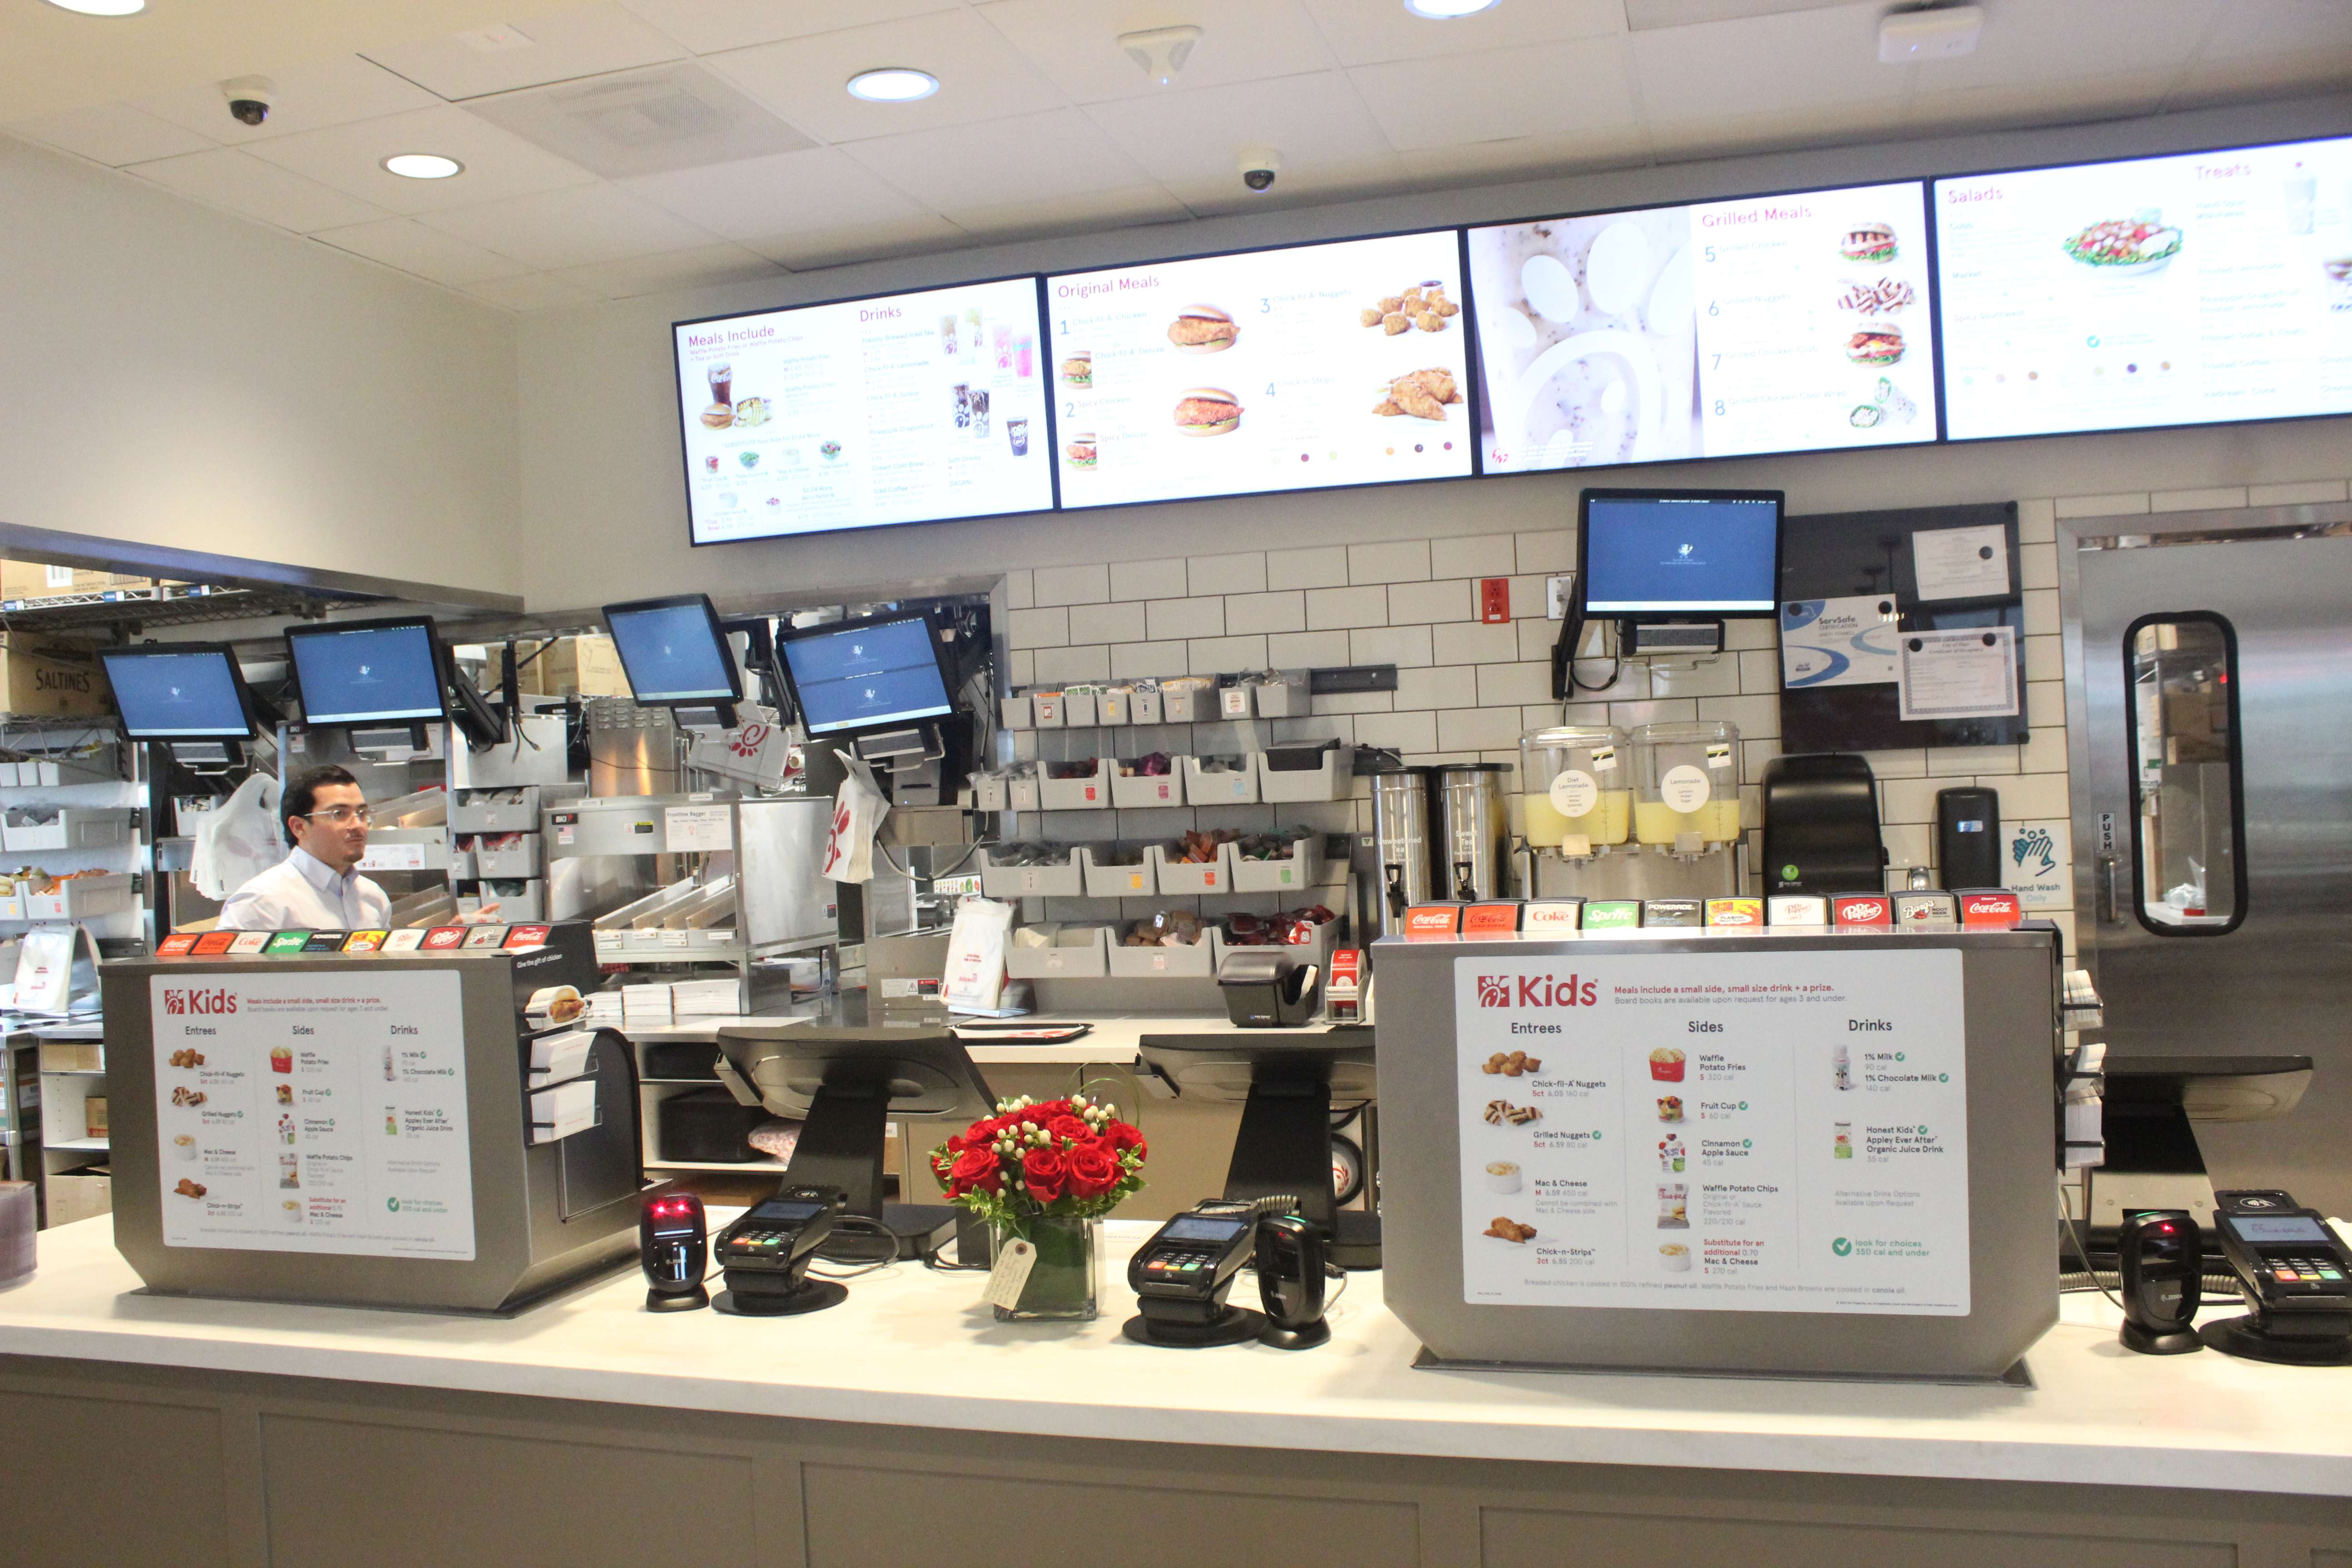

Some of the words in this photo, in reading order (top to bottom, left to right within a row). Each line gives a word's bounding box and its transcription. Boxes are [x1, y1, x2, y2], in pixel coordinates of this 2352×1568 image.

[2195, 163, 2252, 180] Treats
[1948, 186, 2004, 204] Salads
[1702, 210, 1758, 227] Grilled
[1765, 205, 1812, 222] Meals
[1705, 246, 1716, 263] 5
[1058, 279, 1113, 299] Original
[1119, 275, 1160, 291] Meals
[1260, 298, 1270, 314] 3
[1709, 300, 1719, 316] 6
[860, 306, 902, 322] Drinks
[1060, 320, 1069, 335] 1
[689, 333, 724, 347] Meals
[728, 325, 774, 342] Include
[1712, 354, 1722, 370] 7
[1265, 382, 1276, 397] 4
[1078, 400, 1098, 408] Spicy
[1100, 397, 1131, 405] Chicken
[1715, 400, 1725, 416] 8
[1066, 402, 1075, 417] 2
[1122, 431, 1148, 439] Deluxe
[35, 669, 90, 692] SALTINES
[2102, 814, 2112, 850] PUSH
[2027, 894, 2046, 902] Only
[1786, 905, 1810, 913] Pepper
[1847, 906, 1879, 920] Pepper
[1857, 903, 1869, 911] Dr
[1903, 900, 1935, 919] Barq's
[1970, 902, 2011, 913] Coca-Cola
[1412, 914, 1450, 924] Coca-Cola
[1533, 911, 1568, 921] Coke
[1588, 907, 1633, 922] Sprite
[239, 938, 261, 946] Coke
[273, 937, 304, 947] Sprite
[1518, 974, 1597, 1007] Kids
[1615, 985, 1638, 994] Meals
[1641, 985, 1671, 994] include
[1681, 985, 1702, 993] small
[1705, 985, 1725, 993] side,
[1728, 985, 1749, 993] small
[1810, 984, 1834, 993] prize.
[189, 989, 237, 1014] Kids
[186, 1026, 216, 1034] Entrees
[293, 1026, 314, 1034] Sides
[391, 1025, 418, 1034] Drinks
[1511, 1022, 1562, 1034] Entrees
[1688, 1020, 1724, 1033] Sides
[1848, 1019, 1893, 1031] Drinks
[1721, 1103, 1736, 1111] Cup
[1561, 1132, 1590, 1140] Nuggets
[1867, 1137, 1894, 1145] Appley
[1701, 1149, 1724, 1157] Apple
[1867, 1146, 1896, 1154] Organic
